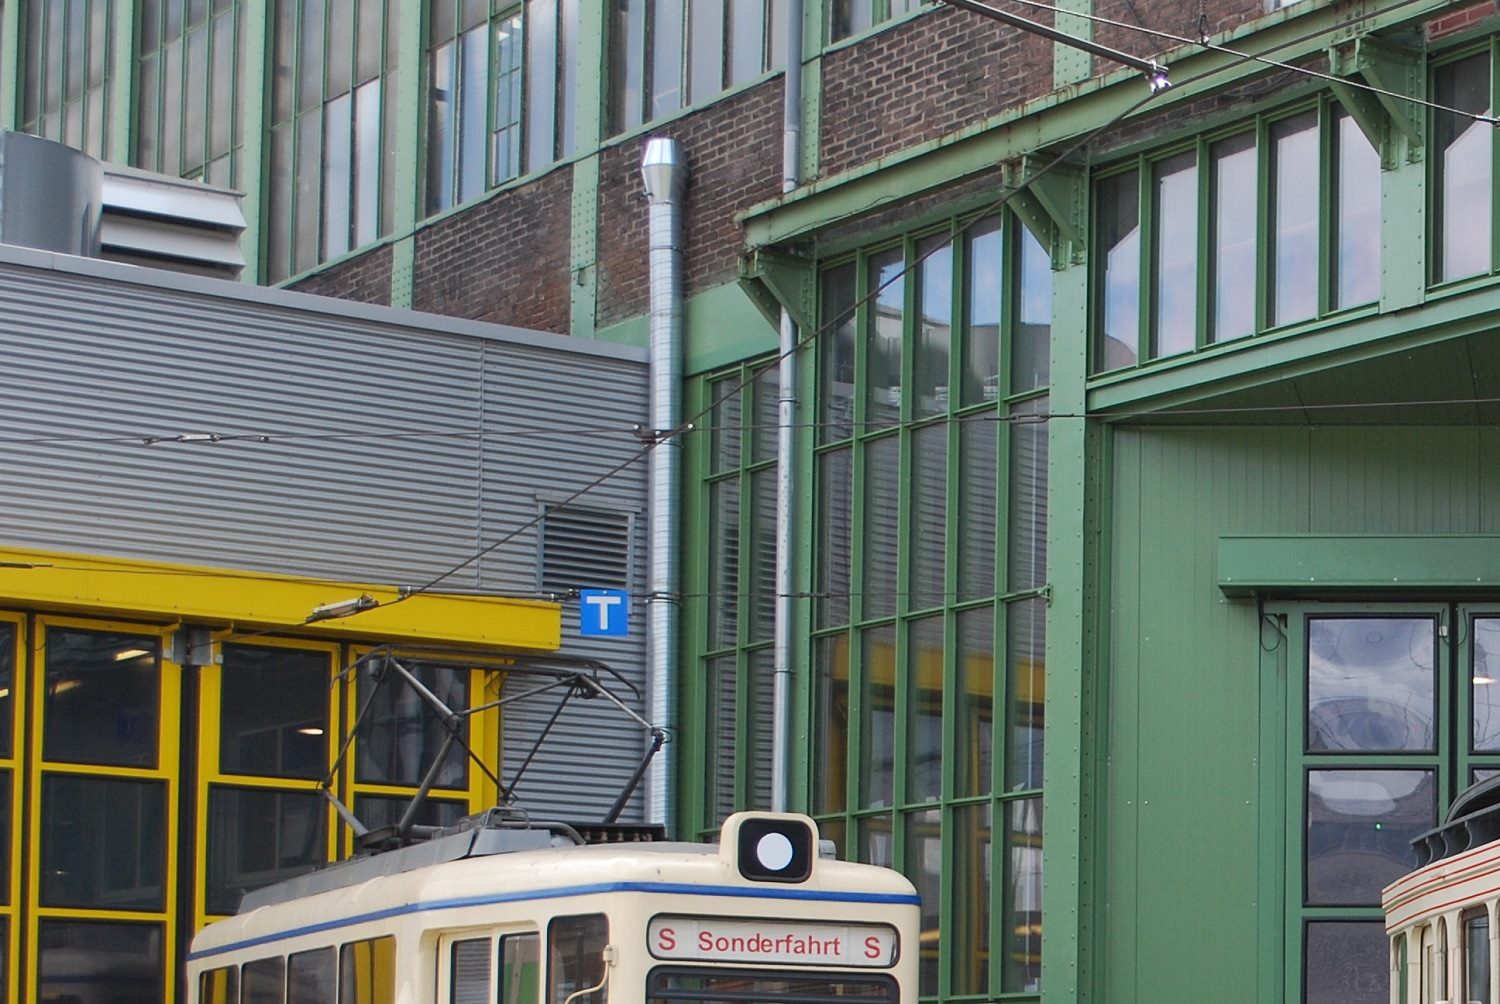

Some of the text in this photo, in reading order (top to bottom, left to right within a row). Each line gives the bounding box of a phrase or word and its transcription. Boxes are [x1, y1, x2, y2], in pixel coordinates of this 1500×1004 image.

[586, 595, 621, 631] T
[658, 928, 881, 959] S Sonderfahrt S
